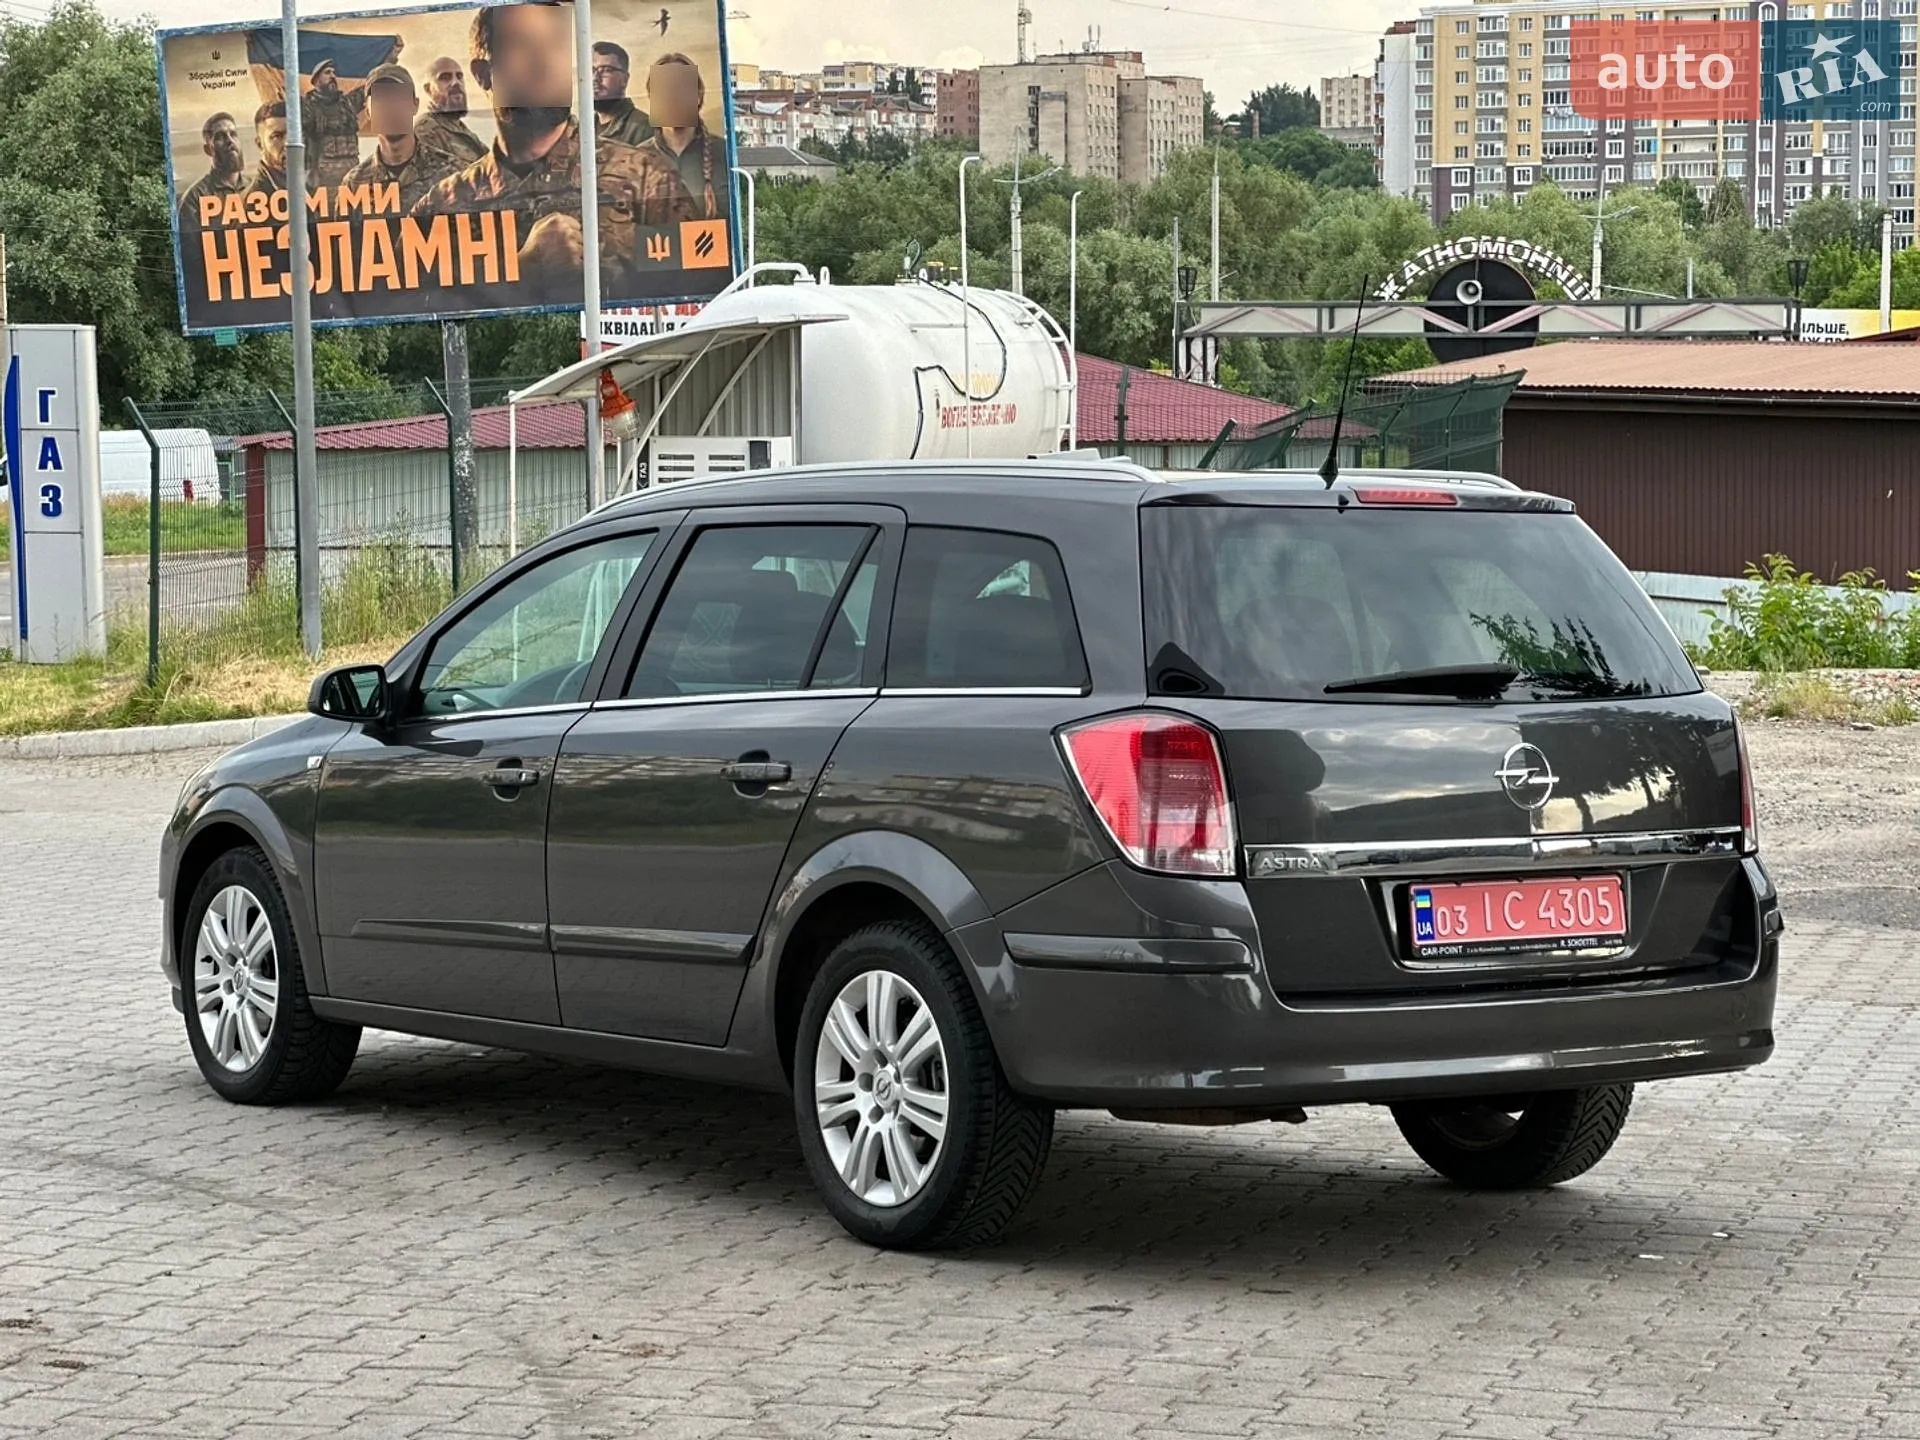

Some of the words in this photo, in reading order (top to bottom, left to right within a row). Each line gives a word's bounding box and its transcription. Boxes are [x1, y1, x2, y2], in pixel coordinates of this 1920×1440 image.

[188, 69, 223, 81] Збройні
[225, 68, 248, 78] Сили
[201, 80, 236, 90] України
[199, 186, 329, 227] РАЗОМ
[337, 181, 401, 216] МИ
[201, 209, 520, 302] НЕЗЛАМНІ
[37, 387, 64, 518] ГАЗ
[1259, 856, 1322, 870] ASTRA
[1436, 904, 1469, 937] 03
[1538, 886, 1614, 929] 4305
[1417, 921, 1434, 936] UA
[1421, 945, 1463, 957] CAR-POINT
